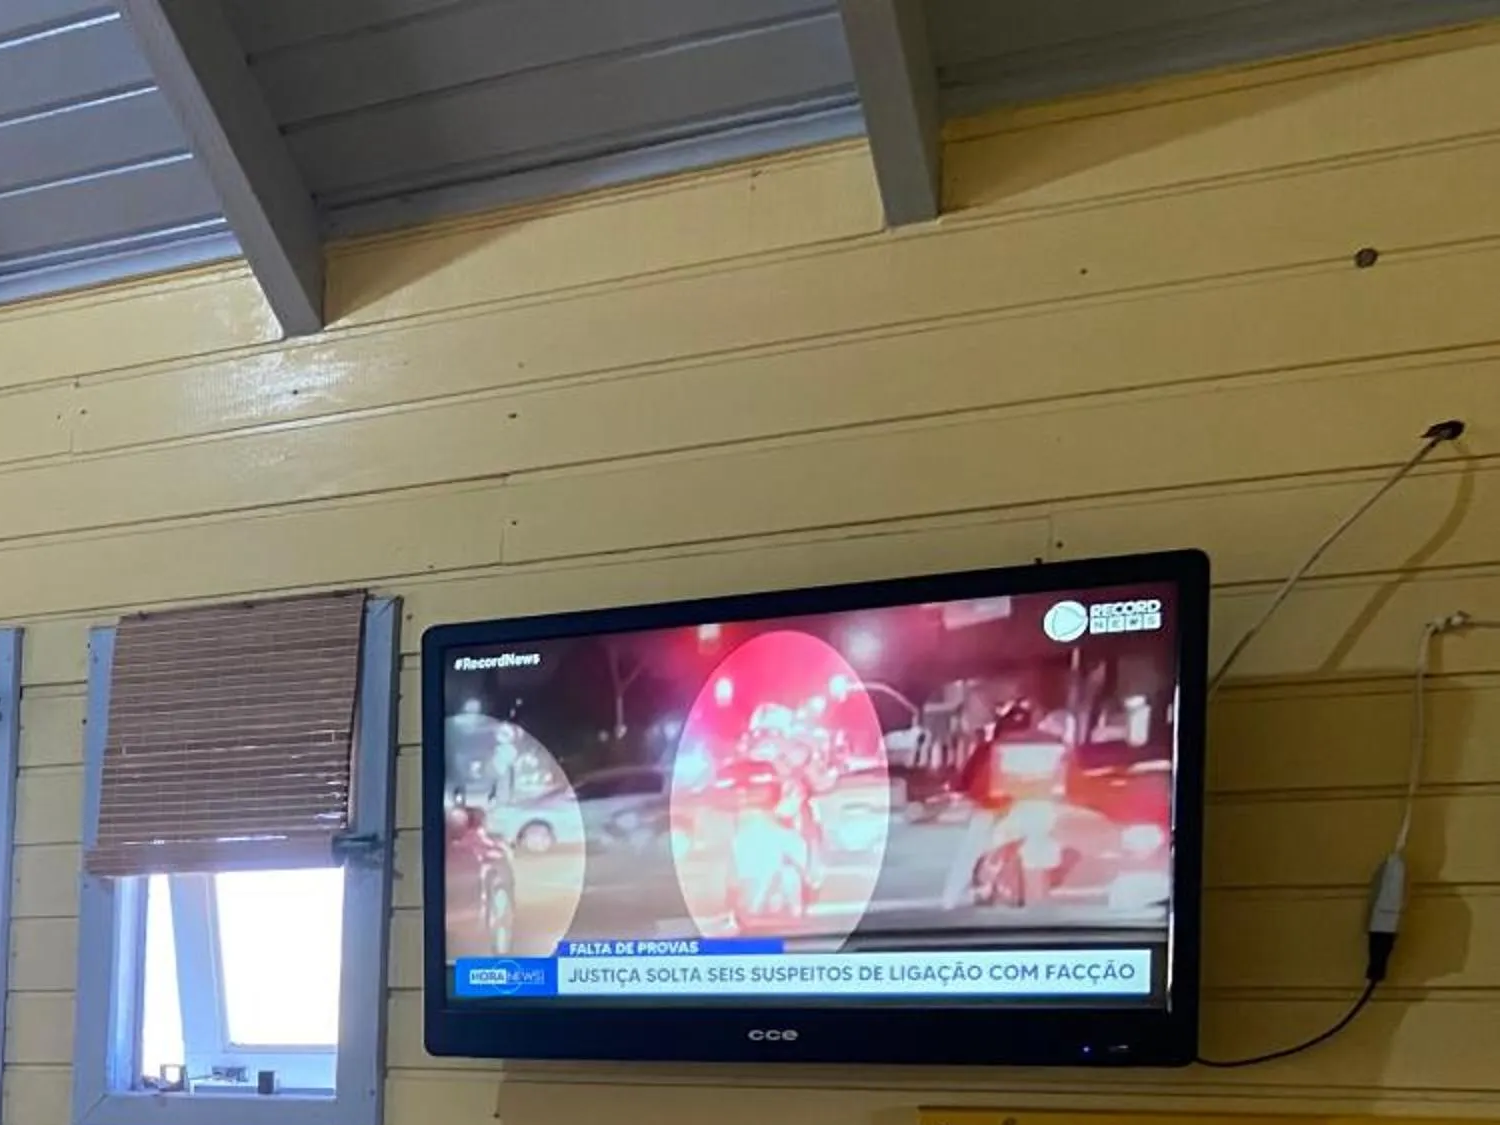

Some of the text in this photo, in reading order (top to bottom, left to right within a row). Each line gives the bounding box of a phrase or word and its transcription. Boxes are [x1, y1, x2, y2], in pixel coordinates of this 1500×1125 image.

[1090, 600, 1161, 617] RECORD
[454, 653, 540, 671] #RecordNews
[569, 941, 699, 955] FALTA DE PROVAS
[471, 969, 505, 982] HORA
[568, 959, 1136, 987] JUSTIÇA SOLTA SEIS SUSPEITOS DE LIGAÇÃO COM FACÇÃO
